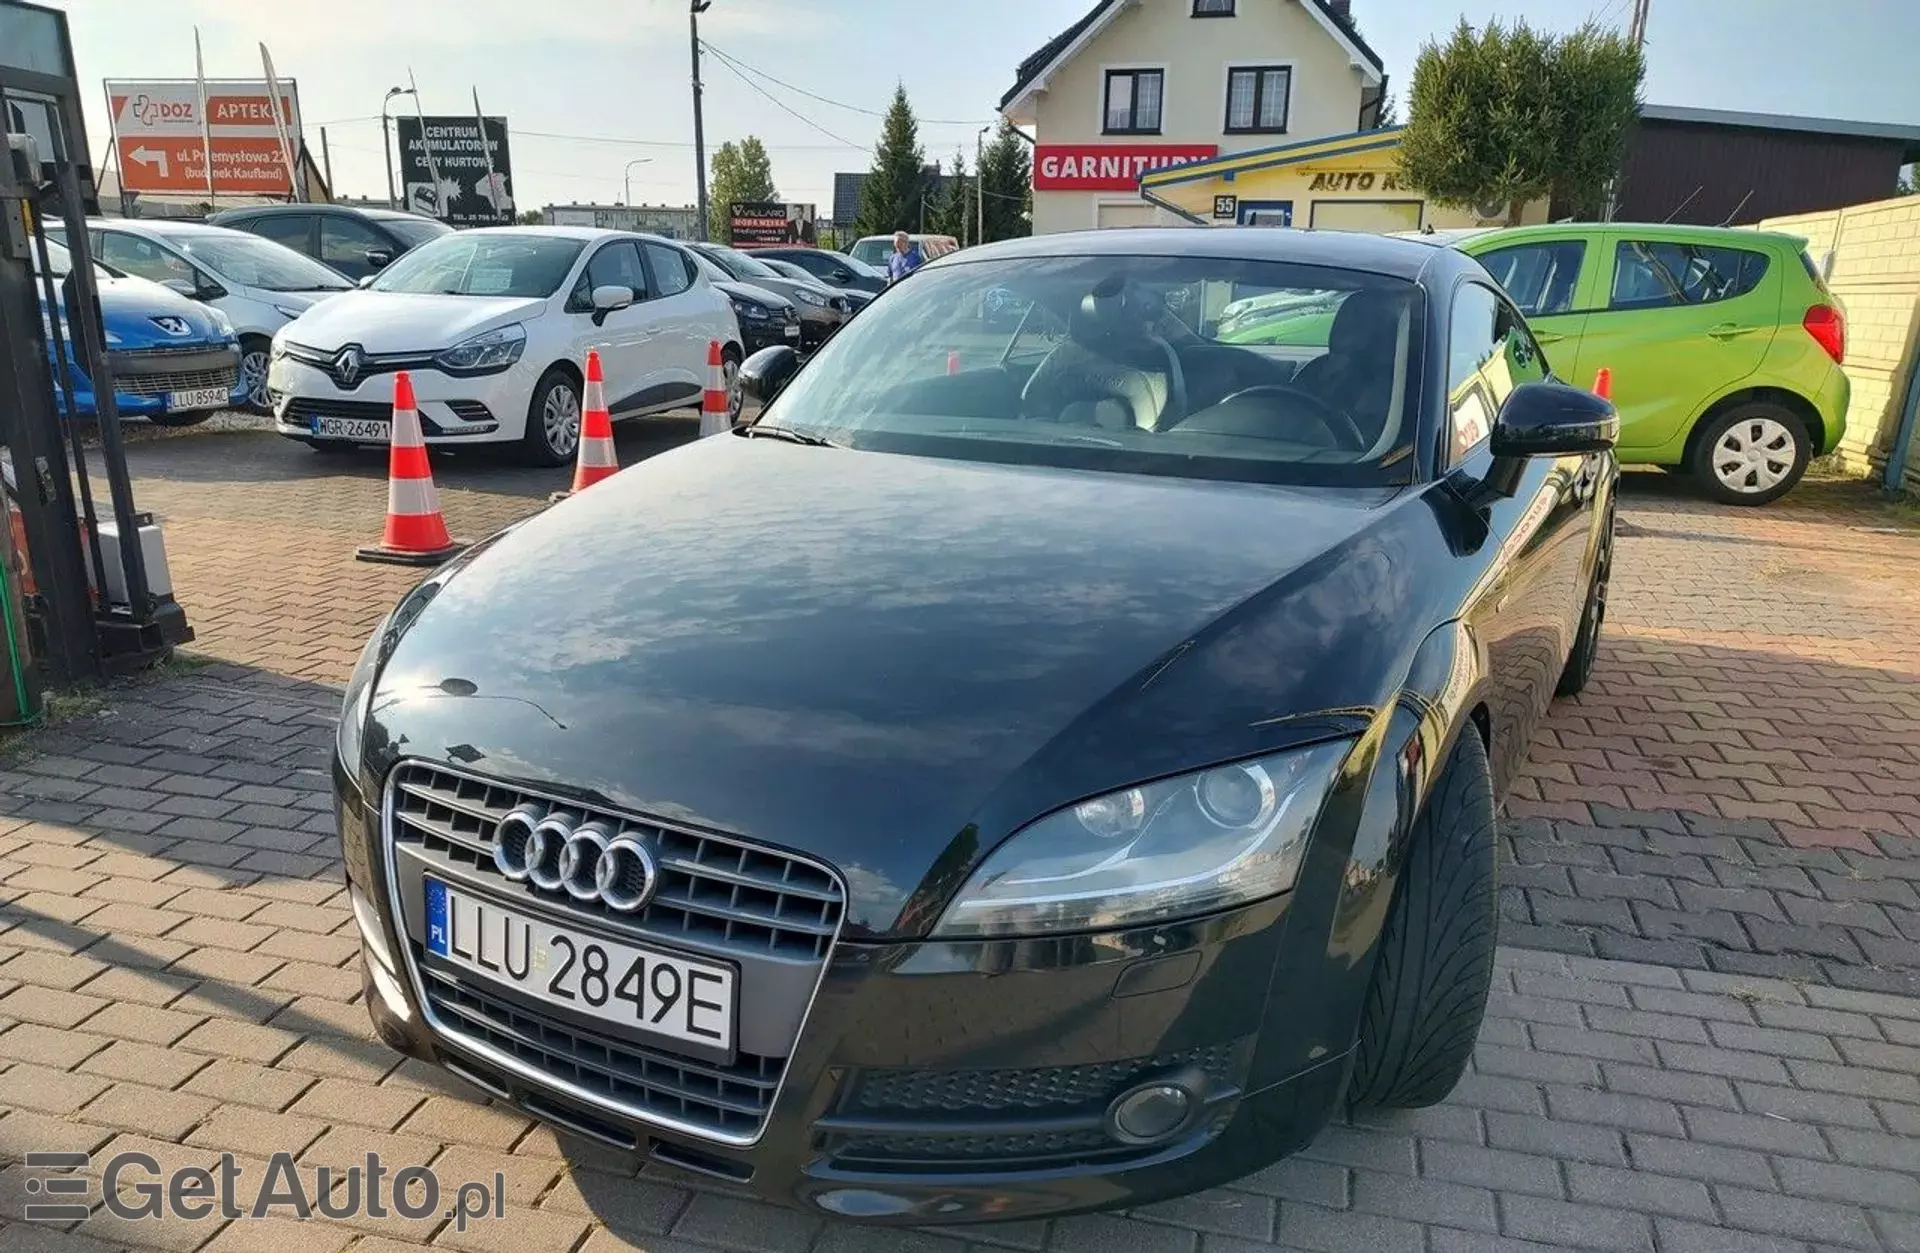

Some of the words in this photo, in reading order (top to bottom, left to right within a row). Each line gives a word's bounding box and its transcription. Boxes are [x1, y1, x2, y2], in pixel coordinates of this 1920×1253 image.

[160, 103, 193, 117] DOZ
[217, 103, 278, 118] APTEK
[426, 126, 478, 138] CENTRUM
[408, 139, 498, 151] AKMULATORW
[192, 150, 269, 164] Premysłowa
[185, 168, 232, 180] (budnek
[234, 168, 283, 181] Kaufland)
[1308, 171, 1375, 191] AUTO
[1216, 198, 1234, 212] 55
[173, 392, 193, 408] LLU
[347, 421, 389, 438] 26491
[431, 924, 445, 944] PL
[451, 894, 530, 981] LLU
[548, 934, 723, 1041] 2849E
